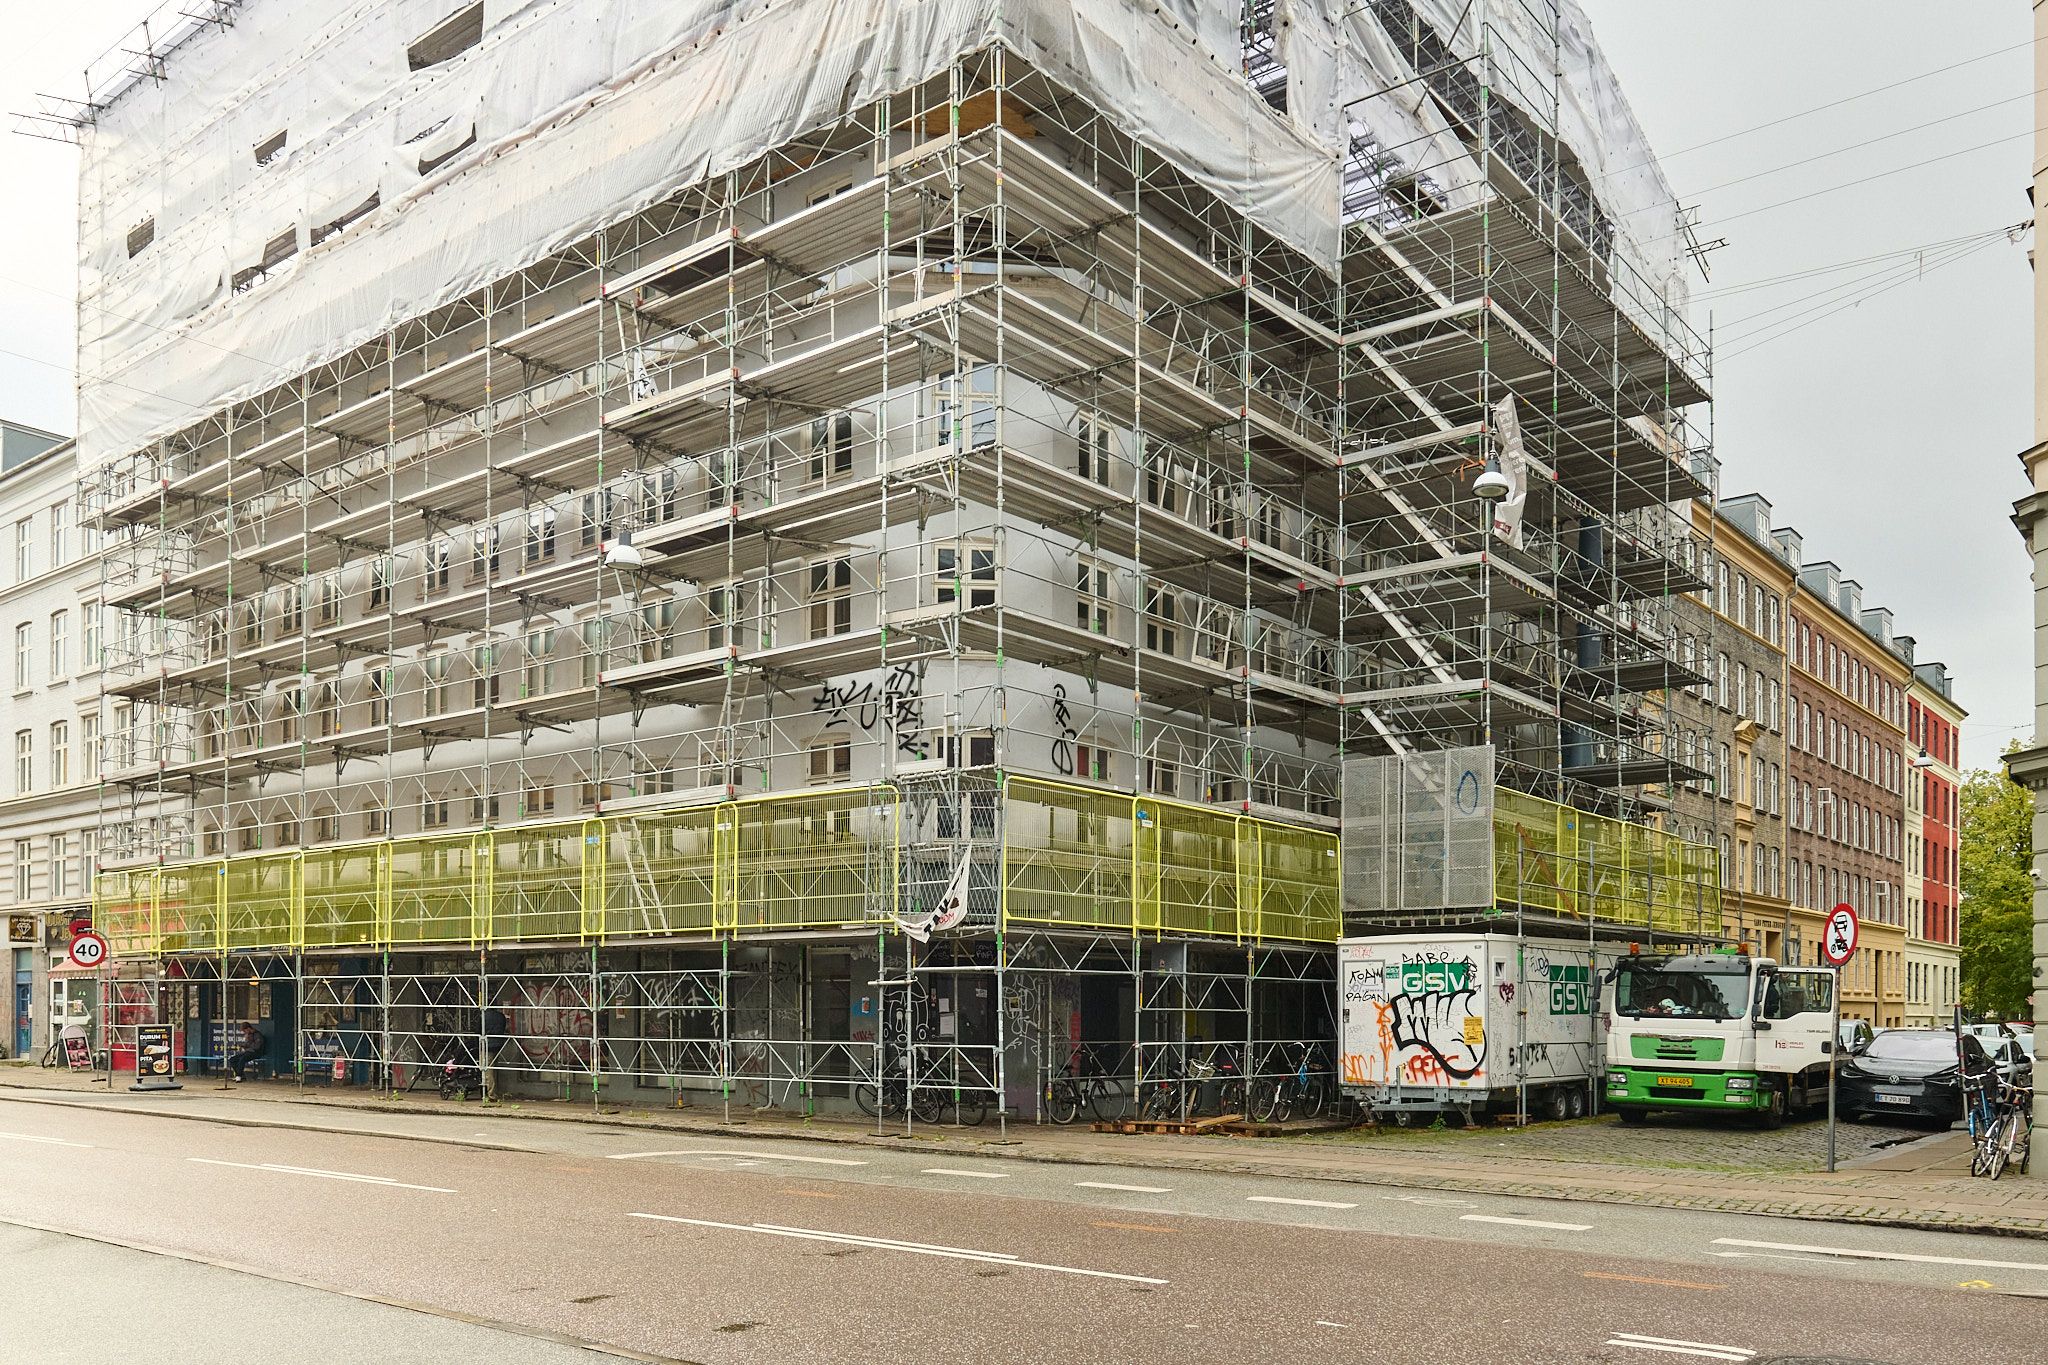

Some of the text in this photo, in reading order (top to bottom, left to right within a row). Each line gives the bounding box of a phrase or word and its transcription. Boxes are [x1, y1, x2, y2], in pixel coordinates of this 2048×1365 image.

[75, 943, 99, 957] 40
[1402, 972, 1470, 992] GSV
[1551, 982, 1590, 1011] GSV
